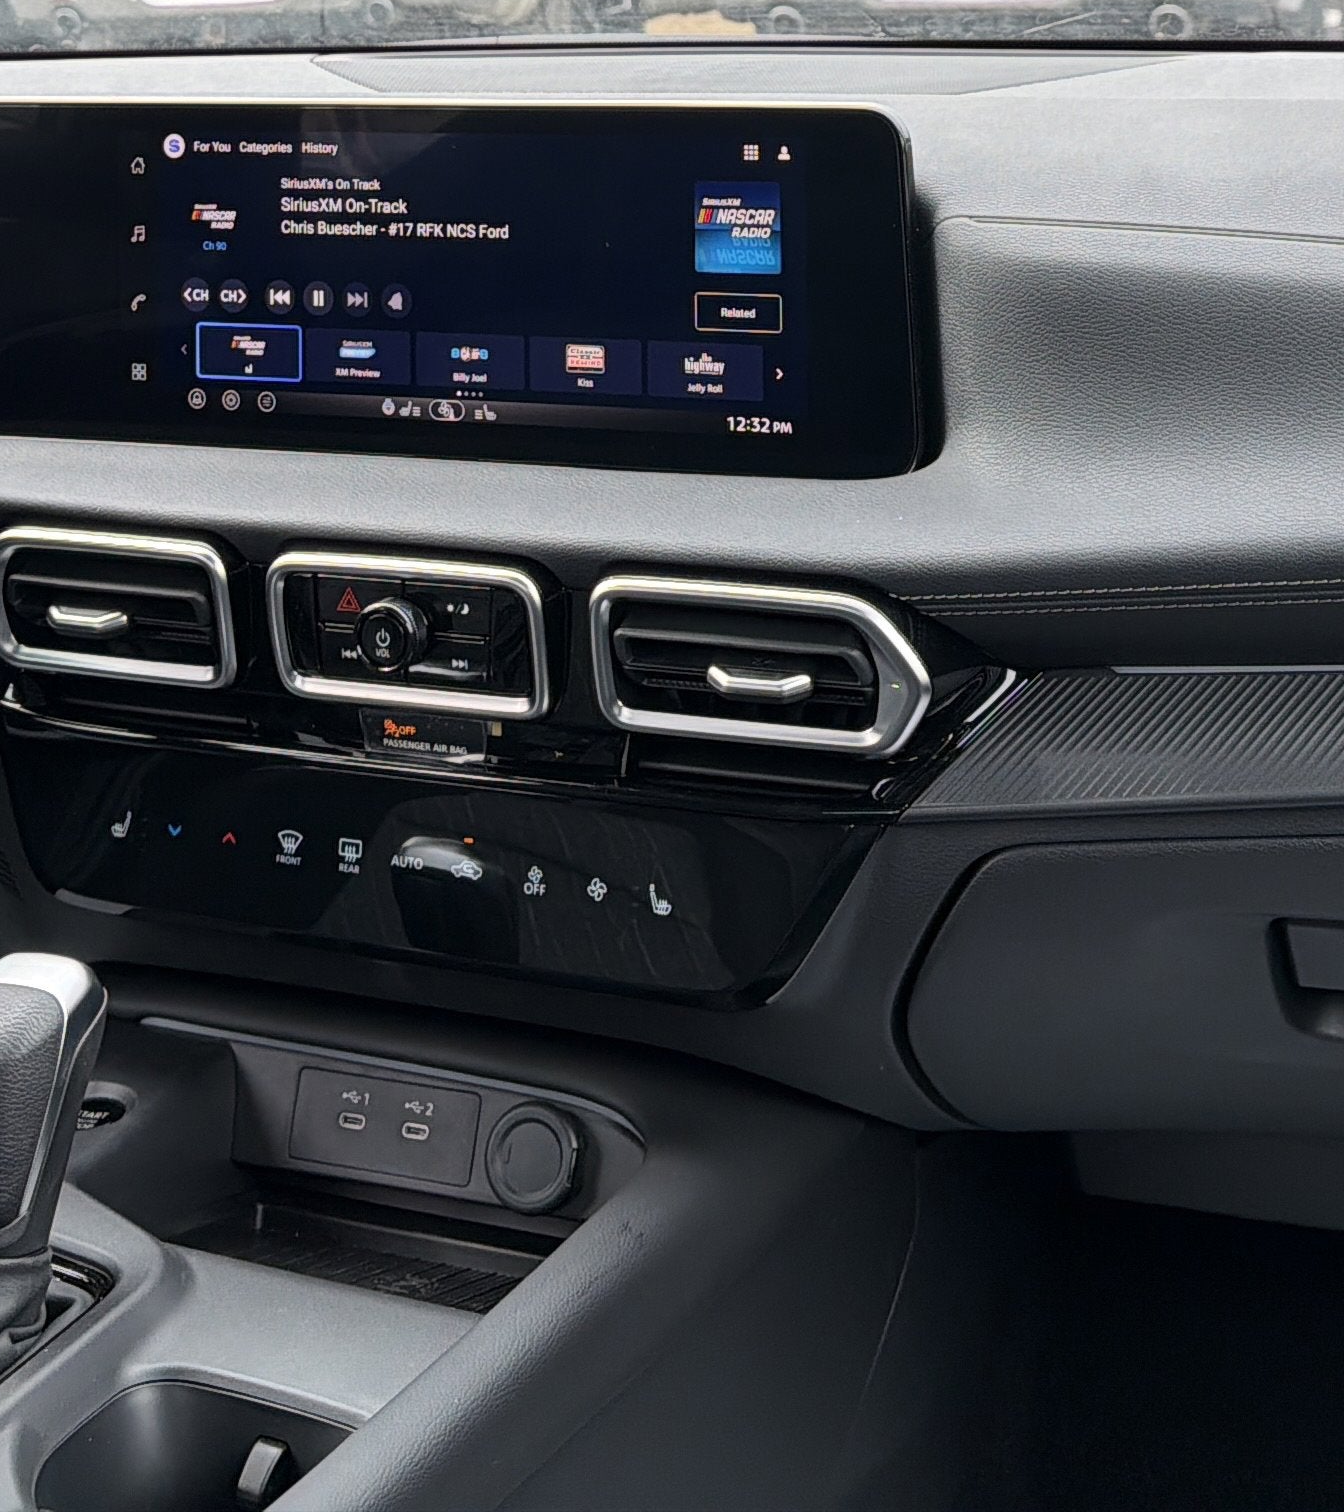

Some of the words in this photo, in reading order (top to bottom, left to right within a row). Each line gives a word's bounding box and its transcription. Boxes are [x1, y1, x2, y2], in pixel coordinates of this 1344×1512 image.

[193, 141, 210, 153] For
[211, 141, 231, 153] You
[239, 141, 292, 154] Categories
[301, 142, 338, 155] History
[281, 178, 333, 190] SiriusXM's
[336, 179, 349, 190] On
[352, 179, 380, 191] Track
[281, 198, 342, 213] SiriusXM
[346, 199, 408, 214] On-Track
[716, 209, 775, 225] NASCAR
[281, 221, 313, 235] Chris
[318, 222, 377, 236] Buescher
[388, 223, 413, 237] #17
[417, 223, 443, 238] RFK
[446, 224, 476, 239] NCS
[479, 225, 509, 240] Ford
[732, 227, 771, 238] RADIO
[203, 241, 214, 250] Ch
[193, 289, 209, 302] CH
[220, 291, 236, 302] CH
[721, 307, 755, 319] Related
[685, 358, 724, 375] highway
[350, 369, 381, 378] Preview
[453, 373, 470, 383] Billy
[472, 374, 487, 383] Joel
[578, 378, 594, 388] Kiss
[688, 383, 706, 394] Jelly
[707, 384, 723, 393] Roll
[727, 417, 770, 433] 12:32
[773, 421, 793, 434] PM
[375, 648, 390, 658] VOL
[400, 726, 416, 735] OFF
[383, 738, 430, 751] PASSENGER
[433, 743, 447, 752] AIR
[450, 744, 467, 755] BAG
[276, 854, 301, 866] FRONT
[391, 854, 423, 870] AUTO
[339, 863, 359, 873] REAR
[523, 882, 545, 896] OFF
[363, 1093, 369, 1106] 1
[426, 1103, 434, 1116] 2
